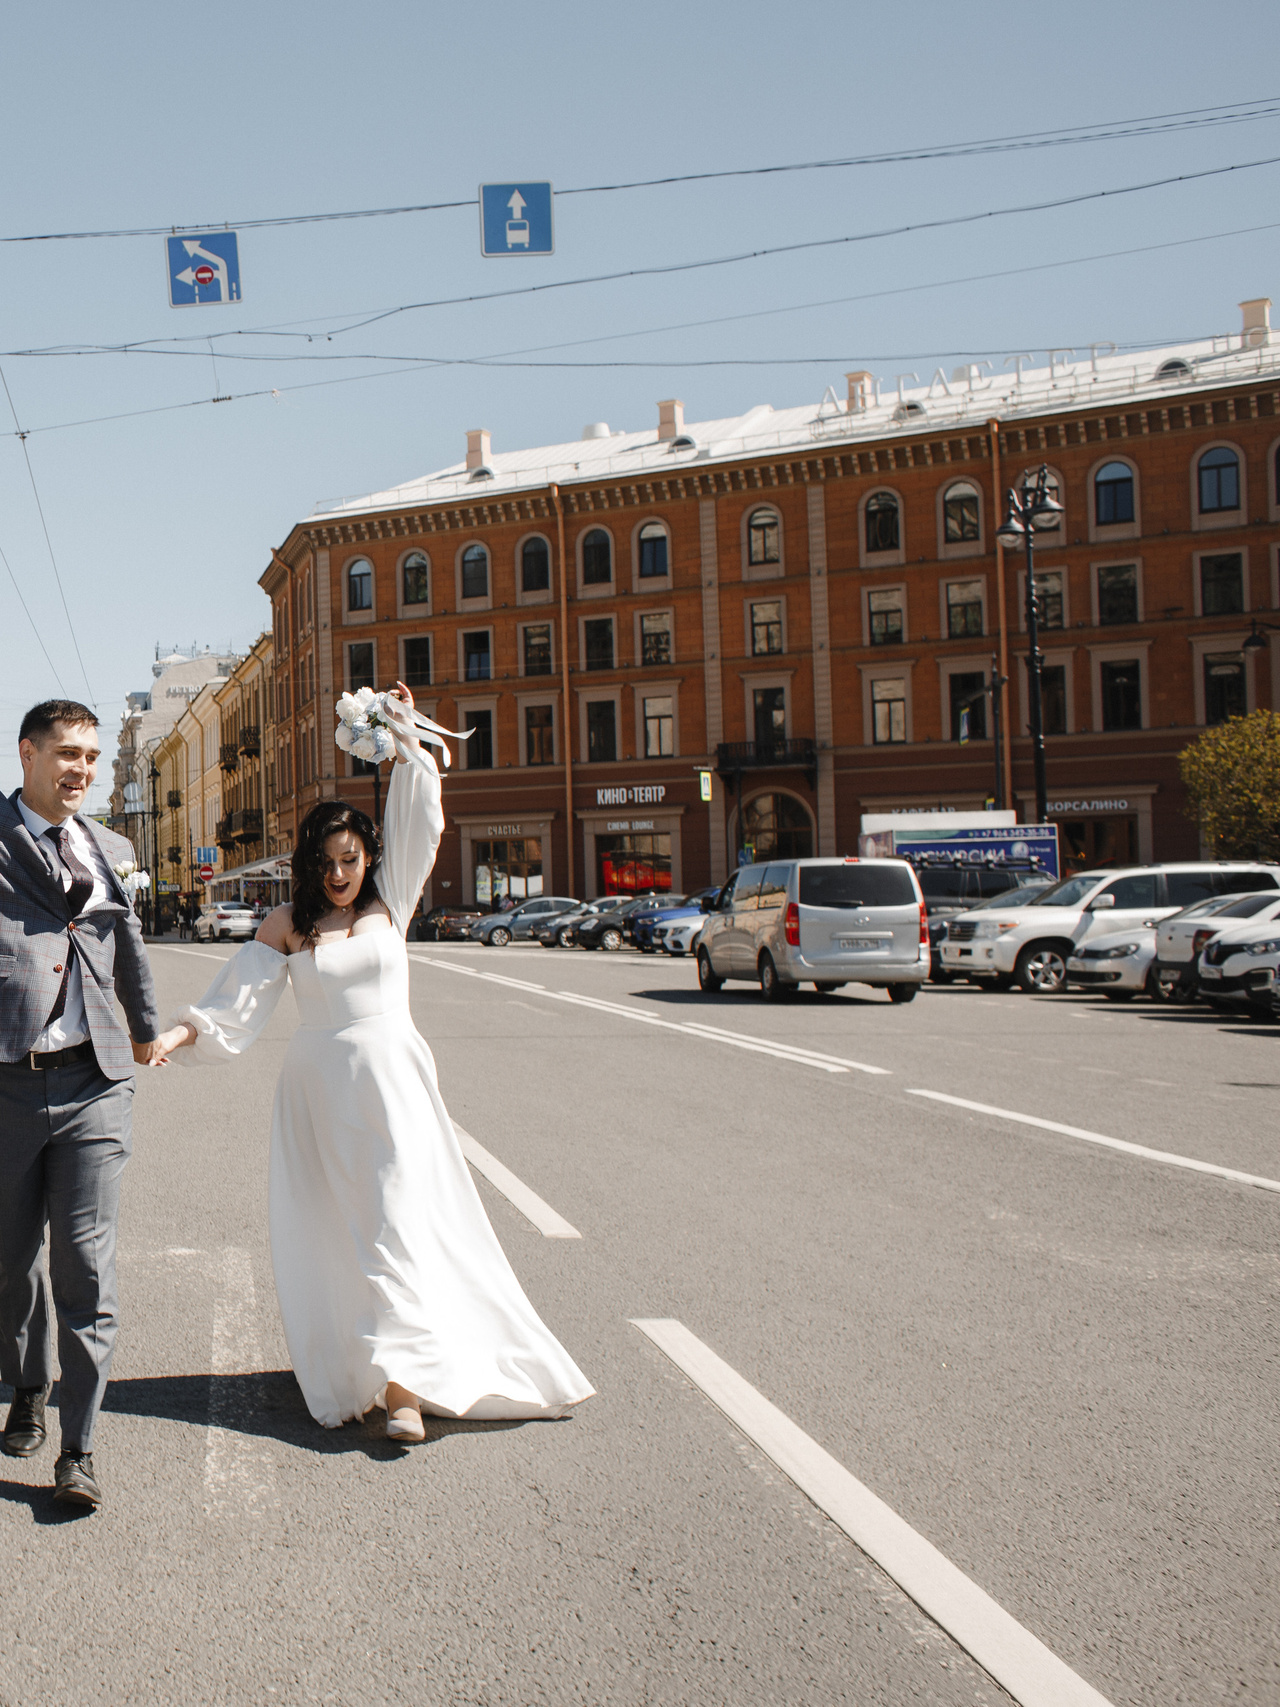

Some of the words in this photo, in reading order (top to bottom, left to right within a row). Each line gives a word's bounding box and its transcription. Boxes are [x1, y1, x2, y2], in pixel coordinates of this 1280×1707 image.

[1045, 799, 1129, 813] БОРСАЛИНО
[487, 824, 522, 836] СЧАСТЬЕ
[606, 820, 630, 831] CINEMA
